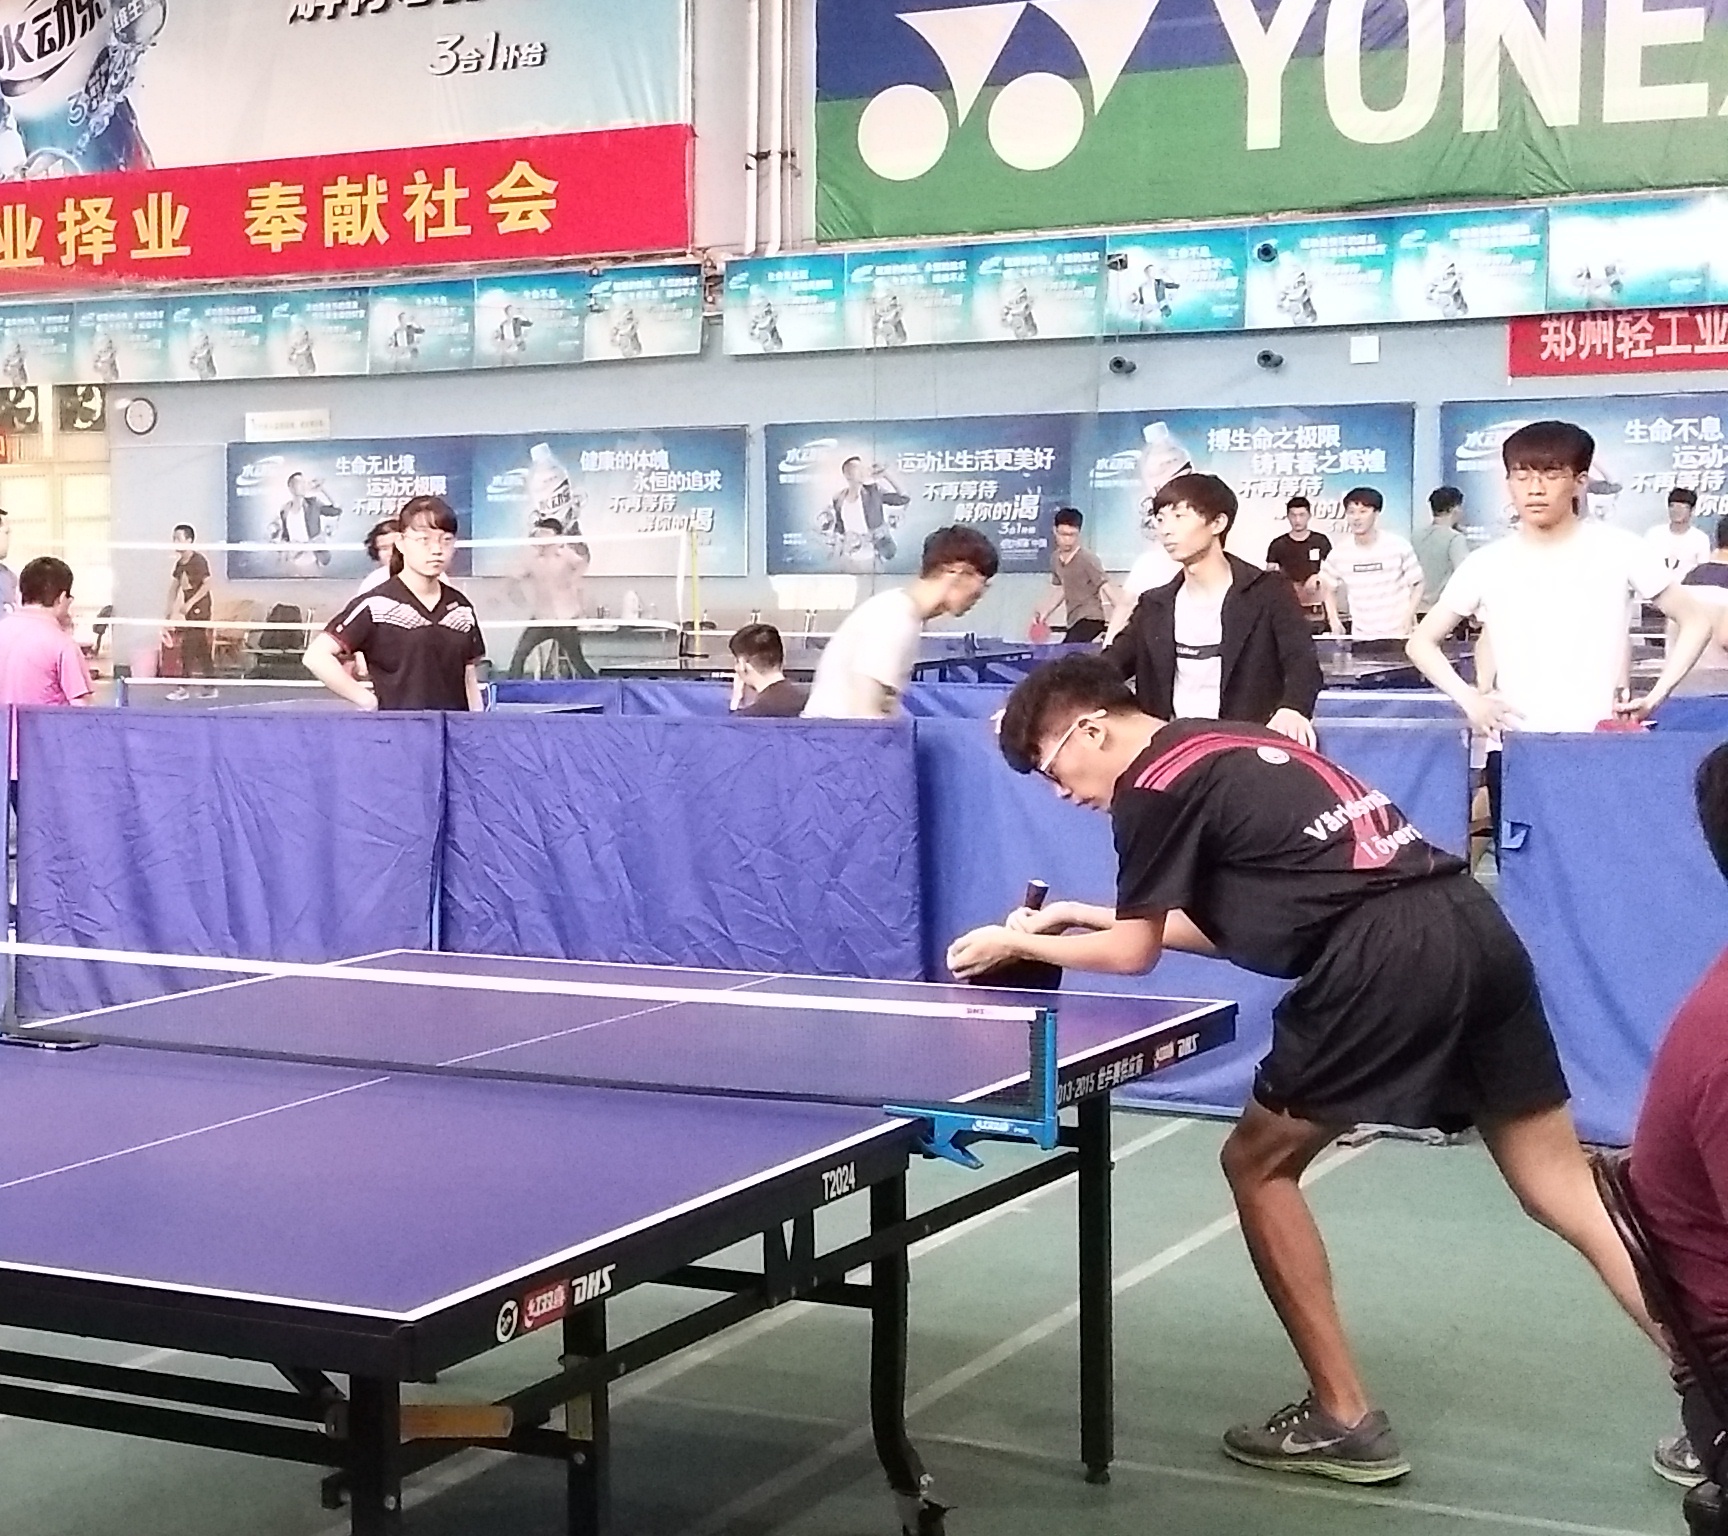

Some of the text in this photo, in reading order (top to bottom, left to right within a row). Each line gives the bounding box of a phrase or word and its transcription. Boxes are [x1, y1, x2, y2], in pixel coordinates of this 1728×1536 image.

[243, 159, 559, 253] 奉献社会
[1207, 424, 1341, 452] 搏生命之极限
[1624, 416, 1724, 444] 生命不息
[335, 454, 416, 476] 生命无止境
[896, 447, 1055, 473] 运动让生活更美好
[632, 470, 722, 493] 永恒的追求
[922, 480, 1000, 502] 不再等待
[1238, 476, 1325, 499] 不再等待
[608, 495, 678, 513] 不再等待
[1056, 1072, 1097, 1105] 013-2015
[821, 1160, 857, 1201] T2024
[571, 1263, 617, 1307] DHS
